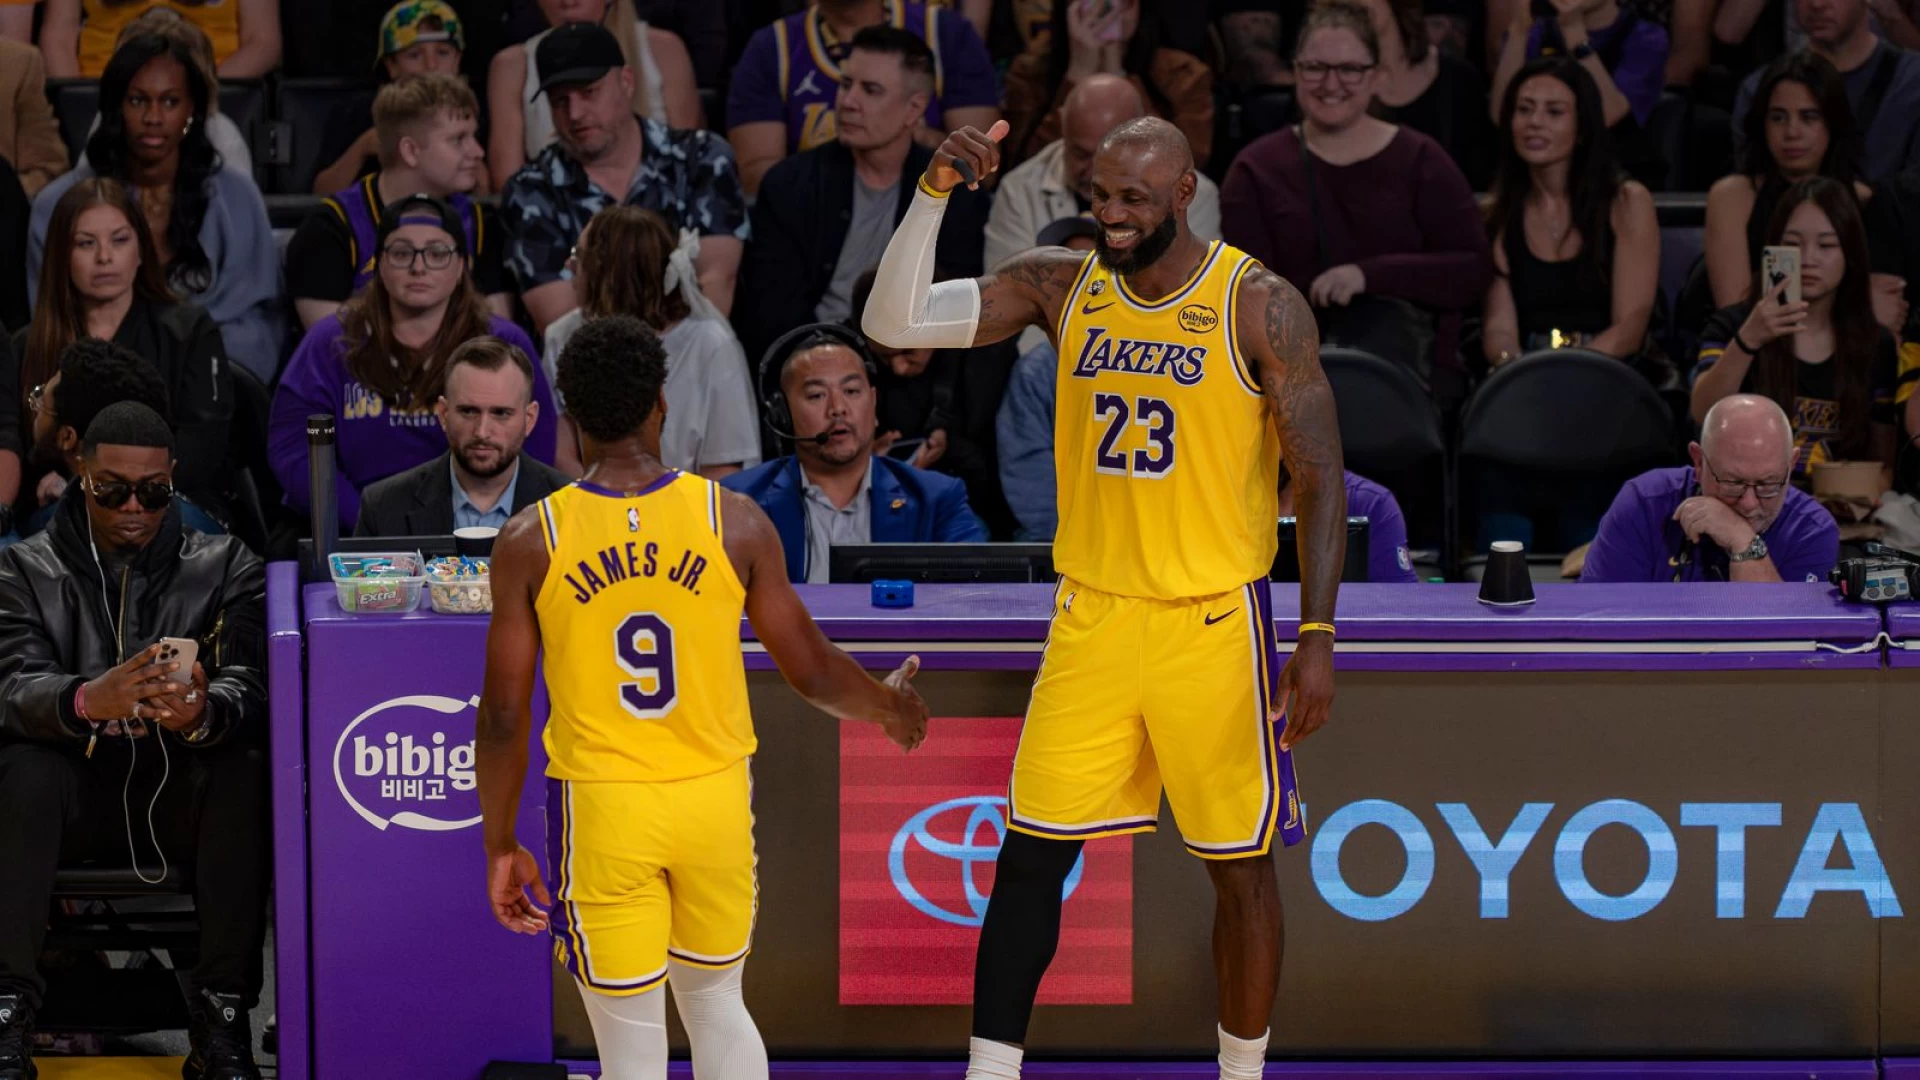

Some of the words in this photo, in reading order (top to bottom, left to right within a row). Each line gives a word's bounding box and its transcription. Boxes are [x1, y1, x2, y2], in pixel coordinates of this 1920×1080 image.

[1182, 311, 1216, 326] bibigo
[1072, 327, 1207, 386] LAKERS
[343, 382, 384, 419] LOS
[1093, 391, 1176, 479] 23
[359, 590, 397, 605] Extra
[564, 541, 658, 604] JAMES
[668, 549, 707, 596] JR.
[614, 611, 679, 719] 9
[354, 731, 477, 791] bibig
[381, 779, 447, 801] 비비고
[1301, 798, 1904, 922] OYOTA
